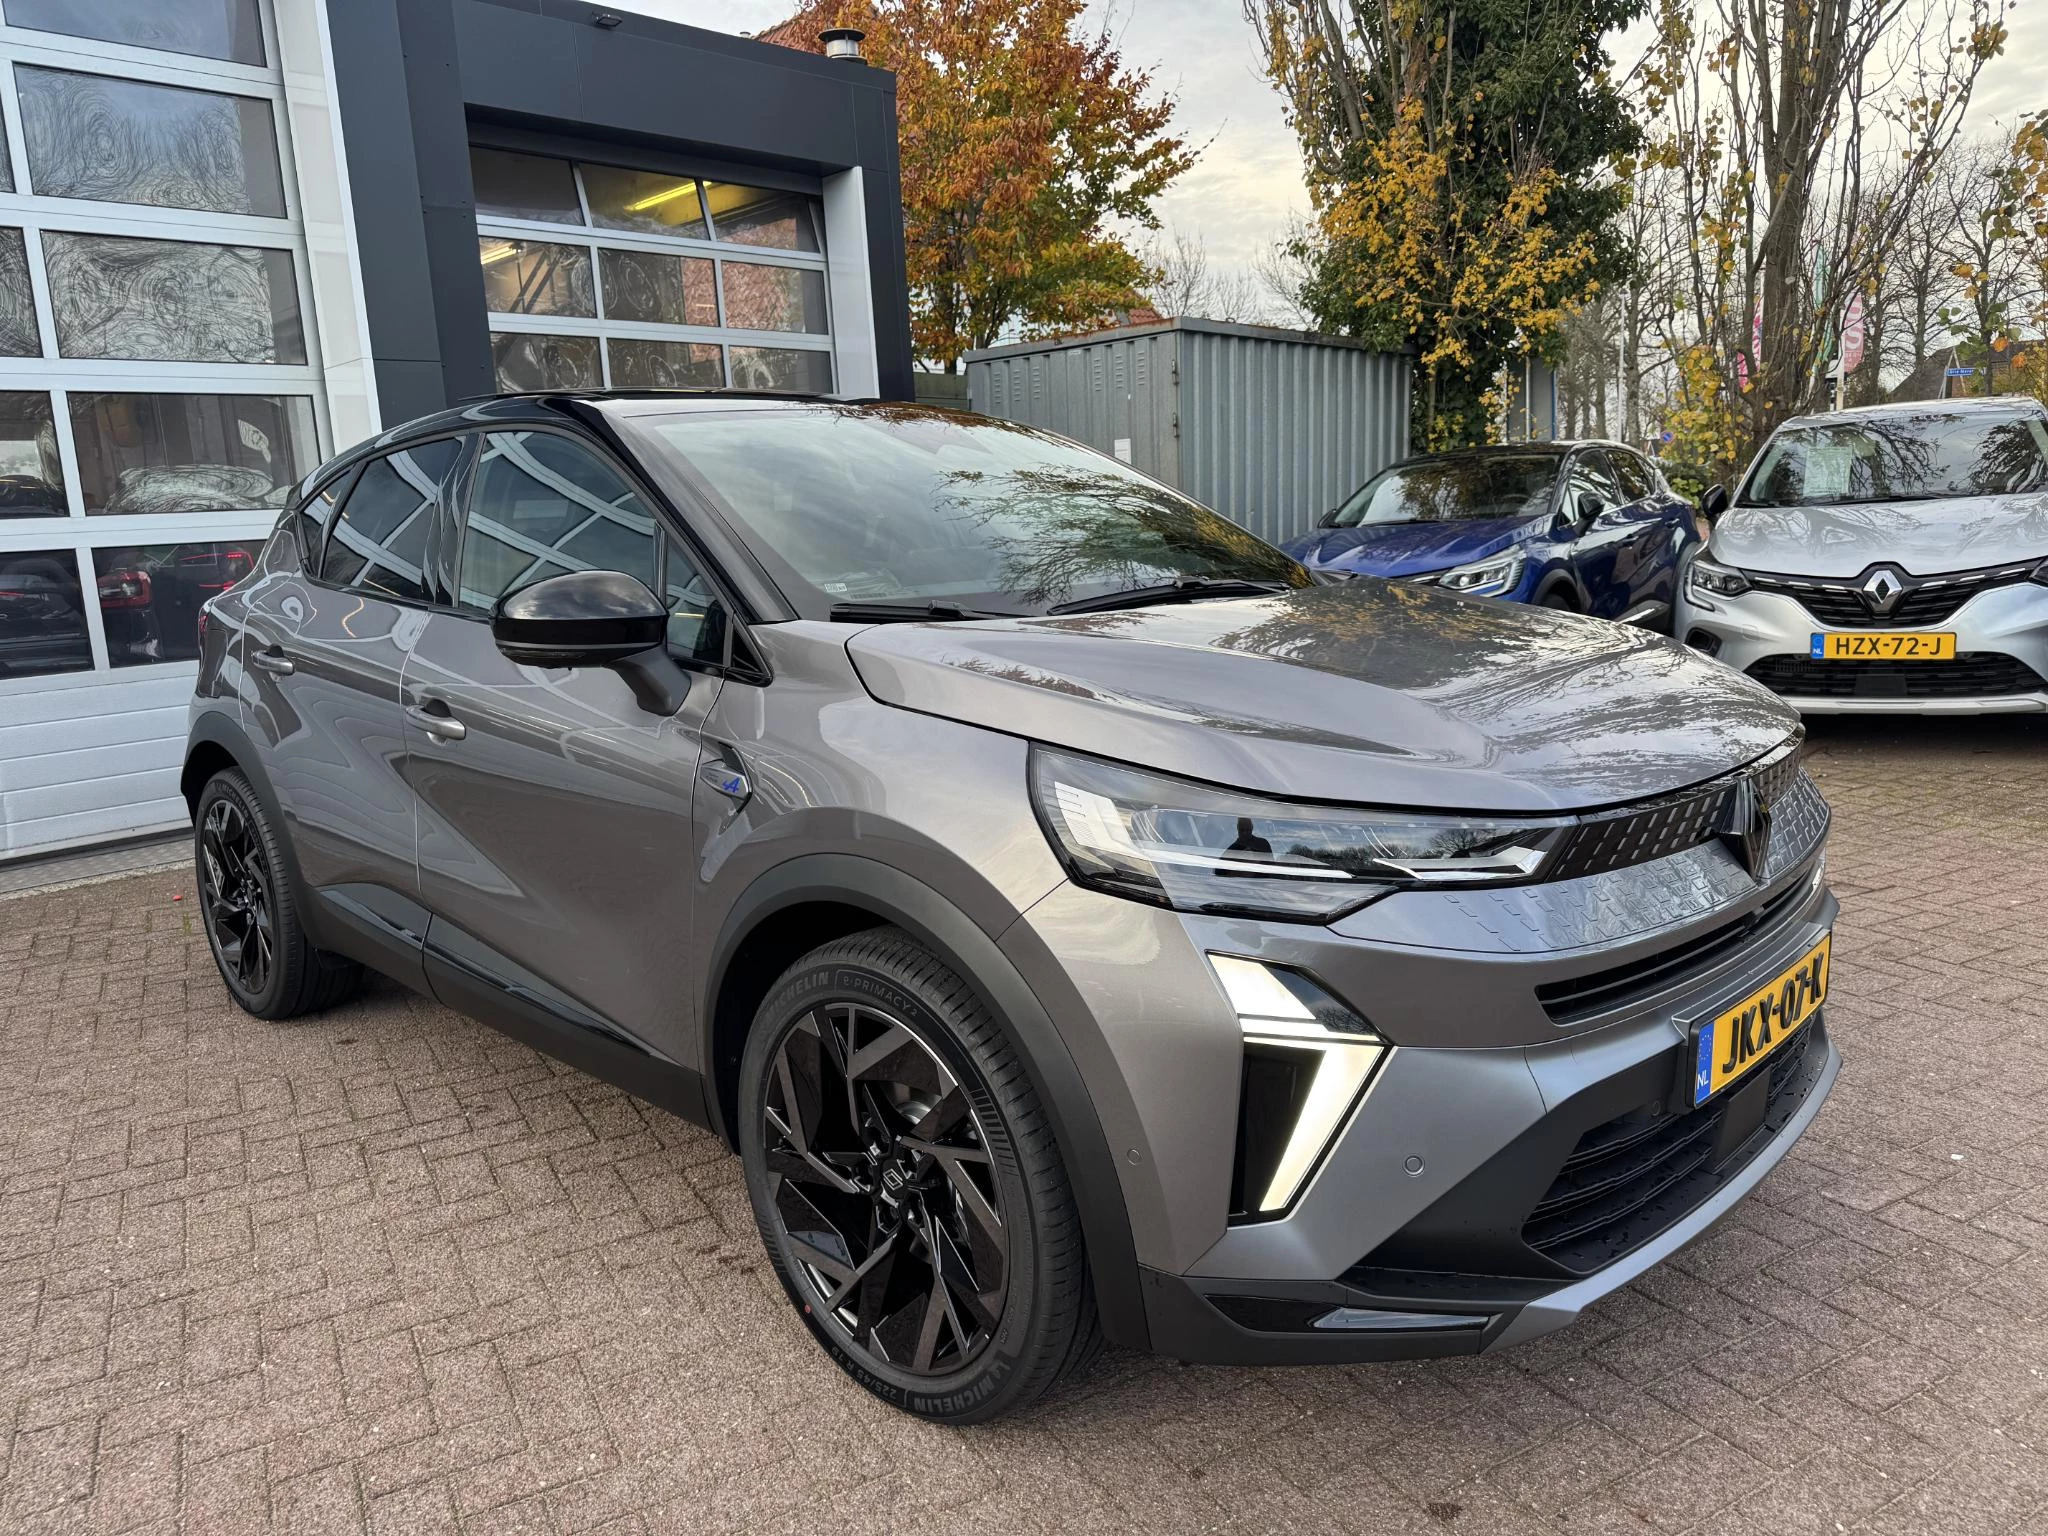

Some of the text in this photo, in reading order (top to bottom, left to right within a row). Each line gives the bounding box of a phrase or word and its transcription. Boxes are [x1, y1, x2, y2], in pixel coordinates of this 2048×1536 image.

[1836, 637, 1941, 655] HZX-72-J
[762, 971, 829, 1022] MICHELIN
[855, 978, 912, 1010] PRIMACY
[1722, 951, 1825, 1074] JKX-07-K
[1696, 1069, 1709, 1090] NL
[845, 1360, 855, 1370] R
[856, 1367, 897, 1400] 225/45
[913, 1375, 995, 1413] MICHELIN
